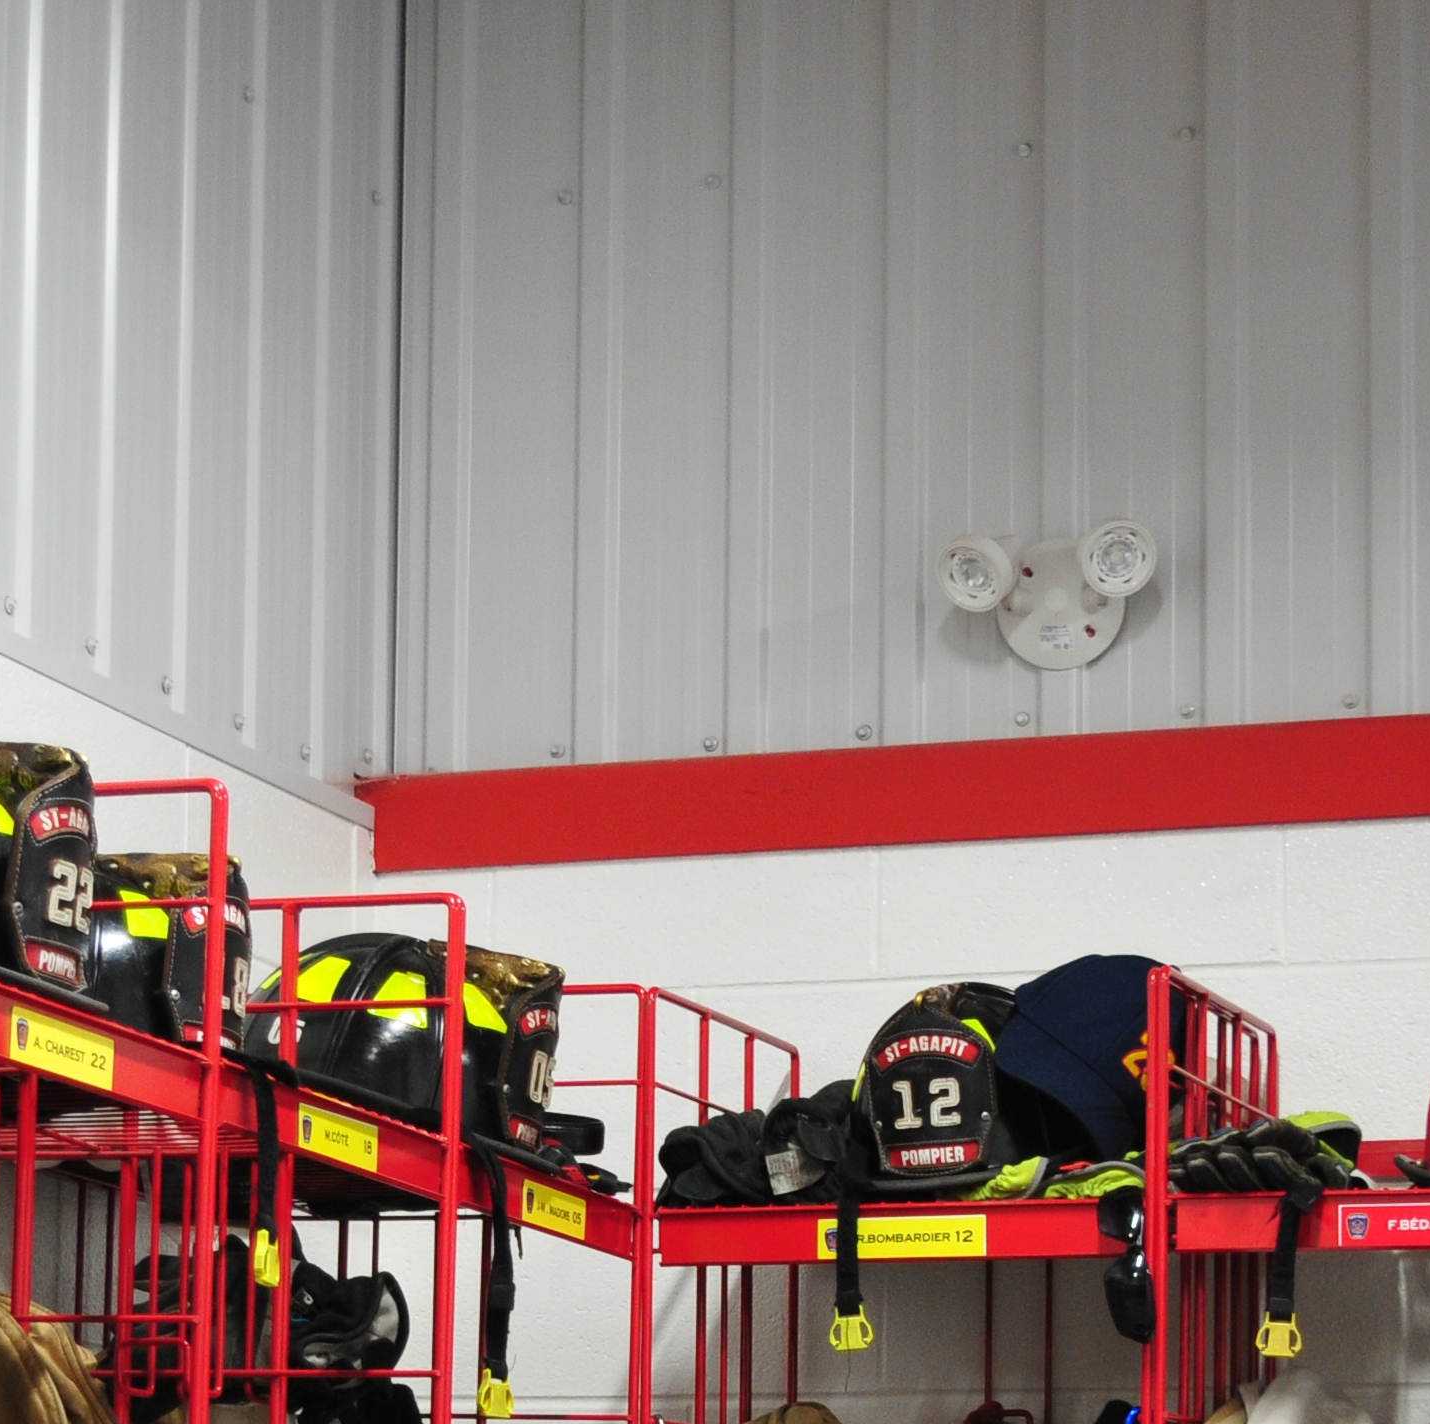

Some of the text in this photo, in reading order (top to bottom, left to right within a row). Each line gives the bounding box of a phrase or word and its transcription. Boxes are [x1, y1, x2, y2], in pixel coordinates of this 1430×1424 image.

[48, 858, 95, 935] 22
[45, 1039, 85, 1064] CHAREST
[90, 1052, 106, 1071] 22
[884, 1035, 969, 1063] ST-AGAPIT
[529, 1050, 557, 1109] 05
[892, 1077, 962, 1130] 12
[363, 1139, 373, 1155] 18
[900, 1145, 965, 1167] POMPIER
[955, 1229, 974, 1243] 12
